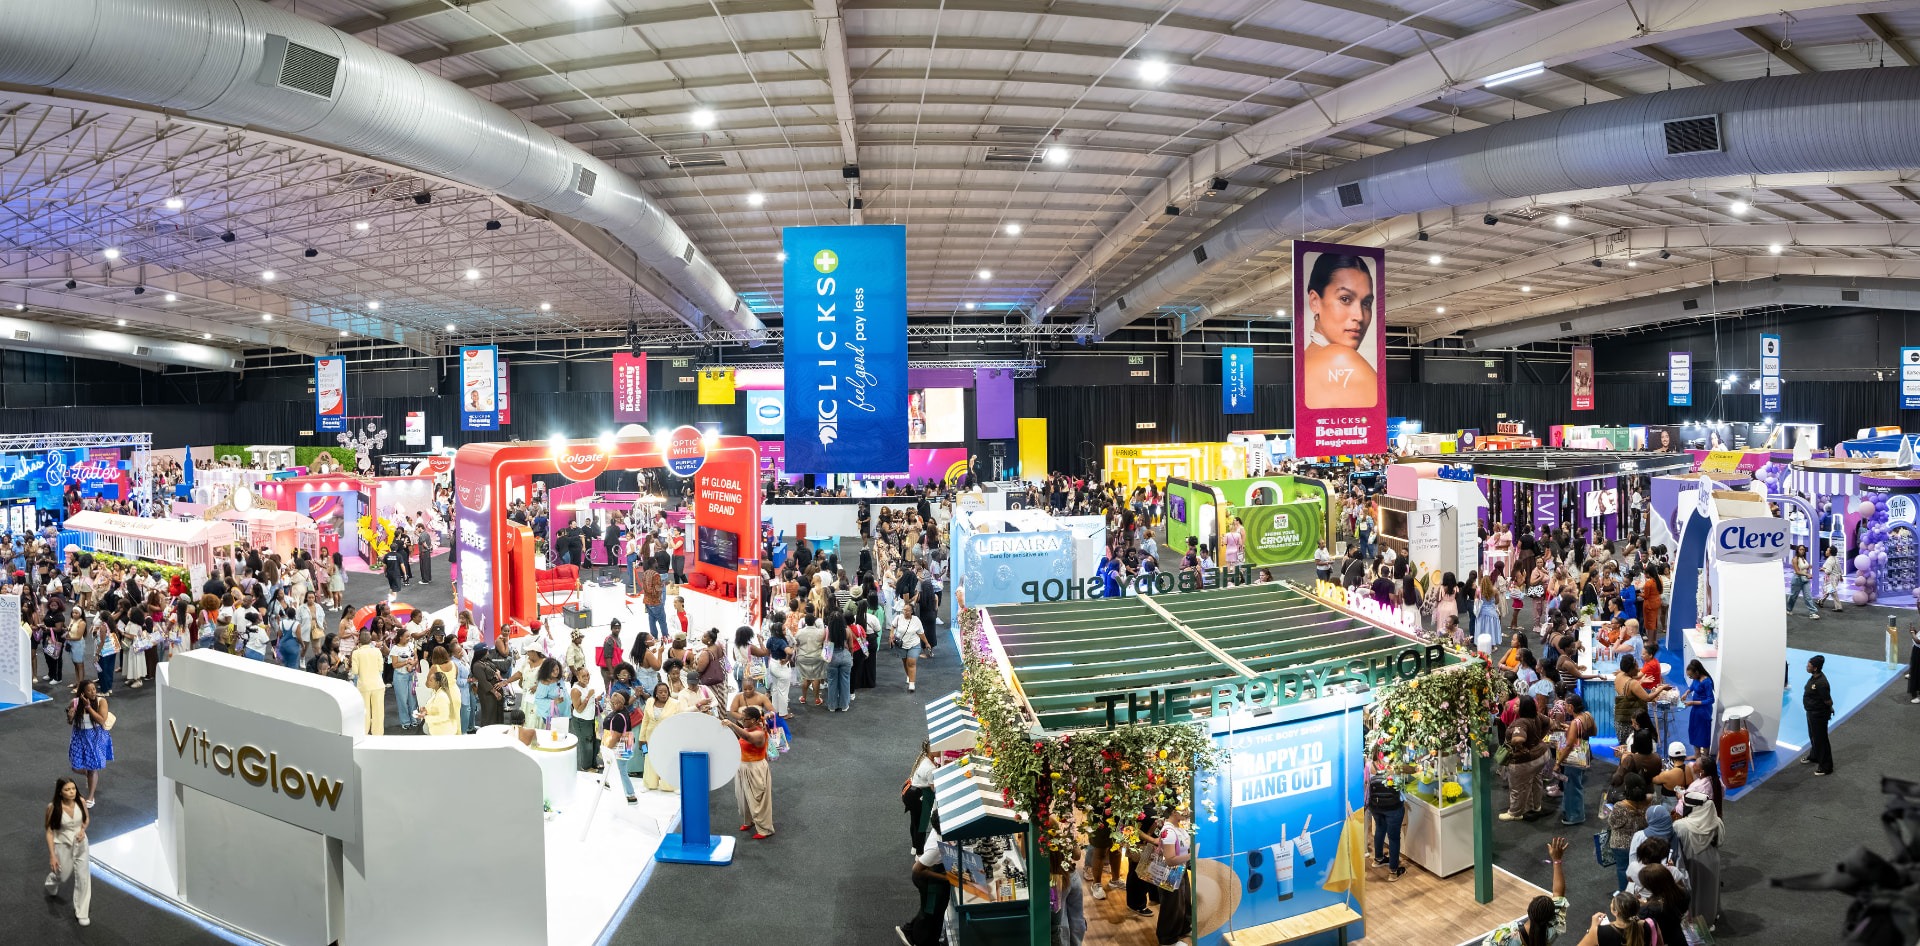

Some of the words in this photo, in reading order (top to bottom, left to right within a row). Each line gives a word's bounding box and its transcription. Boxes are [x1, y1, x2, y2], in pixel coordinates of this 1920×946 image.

[853, 287, 864, 312] less
[855, 315, 867, 341] pay
[816, 277, 838, 419] CLICKS
[845, 341, 877, 388] good
[626, 366, 634, 412] Beauty
[845, 376, 876, 412] feel
[1323, 417, 1361, 425] CLICKS
[1316, 425, 1368, 438] Beauty
[672, 439, 697, 448] OPTIC
[1316, 438, 1368, 447] Playground
[560, 452, 602, 465] Colgate
[701, 477, 710, 486] #1
[711, 477, 742, 491] GLOBAL
[863, 473, 910, 481] Playground
[701, 489, 742, 504] WHITENING
[708, 503, 735, 516] BRAND
[1891, 507, 1906, 517] LOVE
[979, 538, 1058, 553] LENAIRA
[1720, 526, 1784, 549] Clere
[1095, 687, 1193, 731] THE
[1210, 665, 1333, 718] BODY
[1344, 645, 1445, 689] SHOP
[1255, 734, 1273, 744] THE
[1276, 728, 1299, 740] BODY
[1300, 724, 1324, 734] SHOP
[1731, 745, 1746, 753] Clere
[169, 718, 345, 812] VitaGlow
[1240, 746, 1299, 778] HAPPY
[1301, 741, 1323, 765] TO
[1241, 774, 1288, 802] HANG
[1291, 766, 1324, 791] OUT
[943, 845, 977, 867] VANLLA
